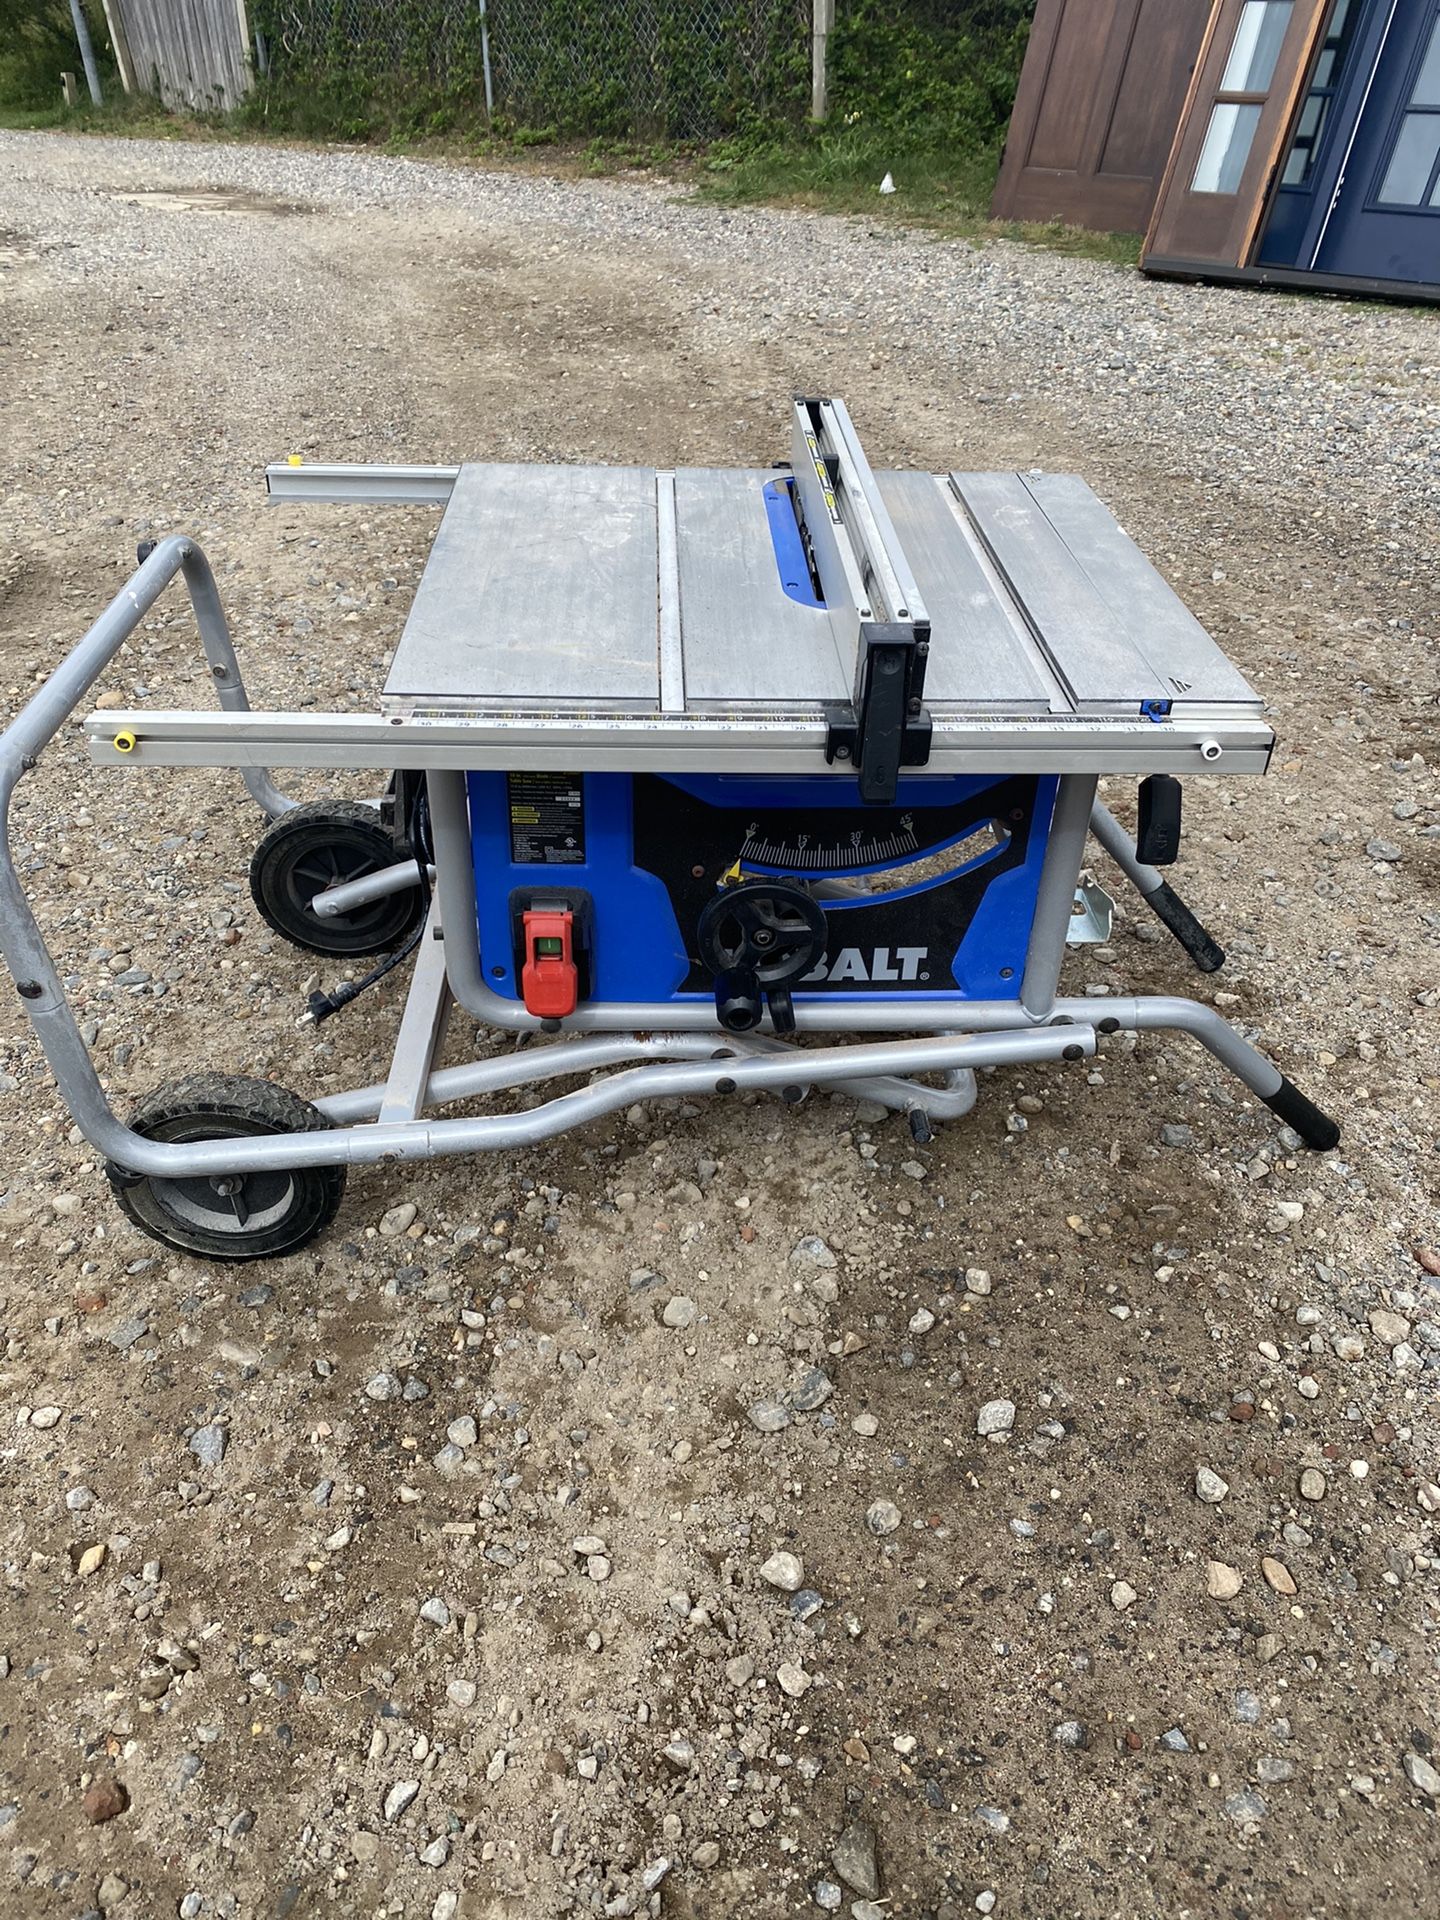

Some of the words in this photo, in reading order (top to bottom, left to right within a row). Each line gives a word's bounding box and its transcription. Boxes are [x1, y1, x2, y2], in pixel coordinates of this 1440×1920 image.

[900, 812, 913, 824] 45°
[750, 823, 760, 831] 0°
[798, 834, 810, 843] 15°
[850, 830, 864, 841] 30°
